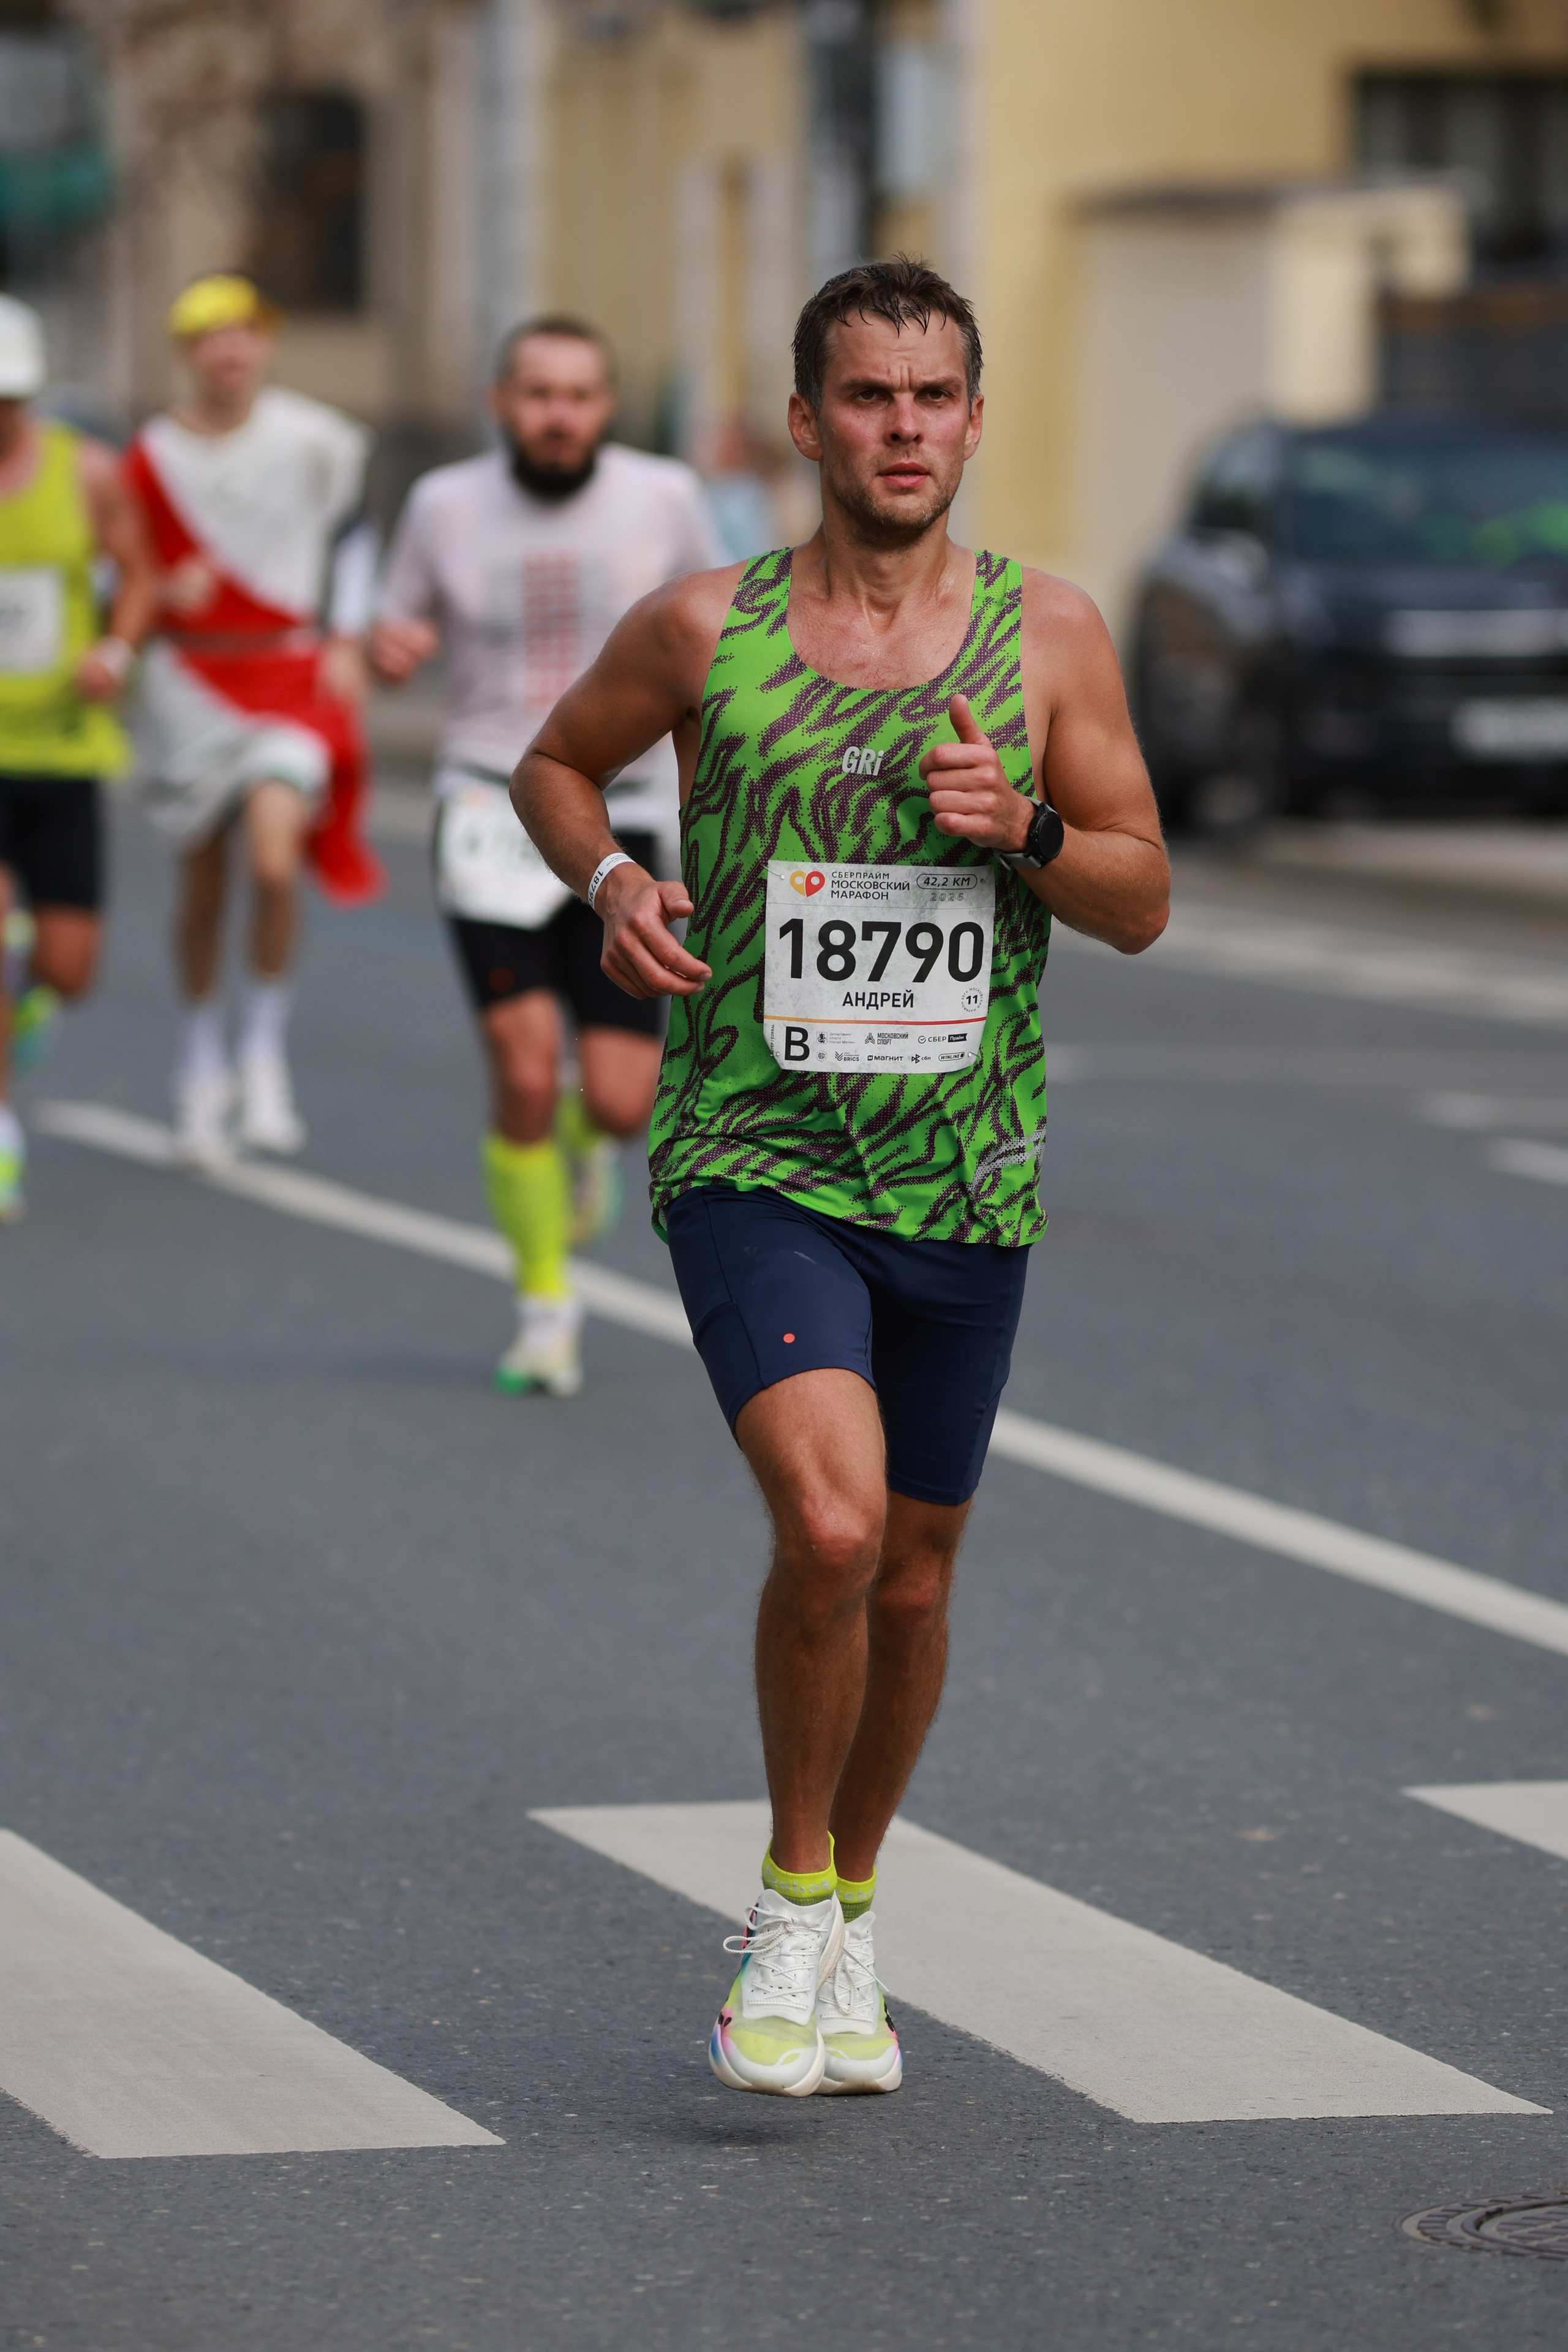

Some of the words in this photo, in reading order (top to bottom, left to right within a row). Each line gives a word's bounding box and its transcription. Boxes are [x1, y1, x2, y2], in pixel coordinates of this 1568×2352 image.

[831, 880, 910, 891] МОСКОВСКИЙ
[924, 877, 948, 887] 42,2
[953, 877, 970, 886] КМ
[831, 891, 889, 900] МАРАФОН
[930, 892, 964, 902] 2026
[779, 918, 984, 982] 18790
[842, 989, 914, 1010] АНДРЕЙ
[966, 995, 978, 1005] 11
[785, 1026, 810, 1061] B
